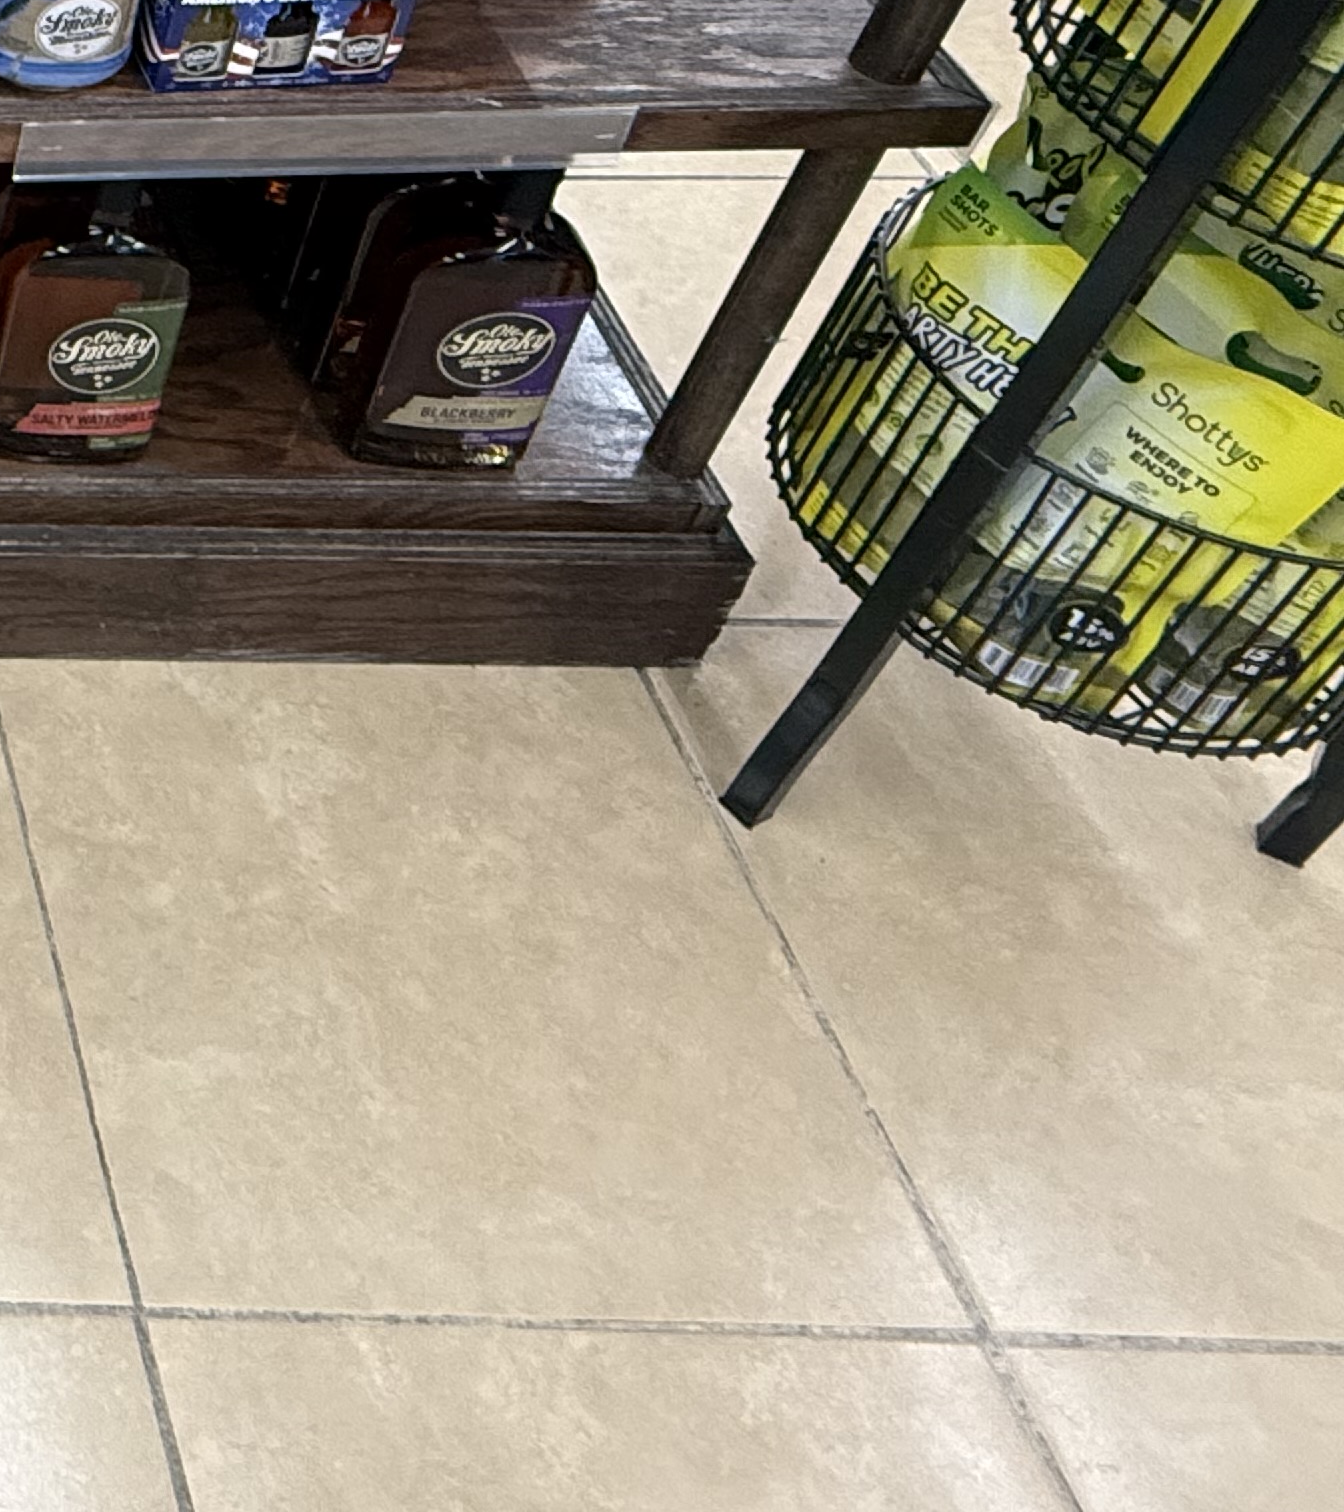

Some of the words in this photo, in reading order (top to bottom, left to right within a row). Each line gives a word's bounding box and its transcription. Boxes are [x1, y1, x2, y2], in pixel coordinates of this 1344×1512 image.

[40, 10, 117, 35] Smoky
[959, 184, 989, 213] BAR
[949, 194, 1000, 237] SHOTS
[912, 261, 969, 322] BE
[55, 333, 156, 363] Smoky
[444, 328, 553, 357] Smoky
[31, 413, 71, 427] SALTY
[77, 411, 158, 426] WATERMELO
[419, 405, 515, 421] BLACKBERRY
[1151, 382, 1269, 472] Shottys
[1126, 426, 1193, 480] WHERE
[1195, 476, 1221, 497] TO
[1128, 450, 1194, 496] ENJOY
